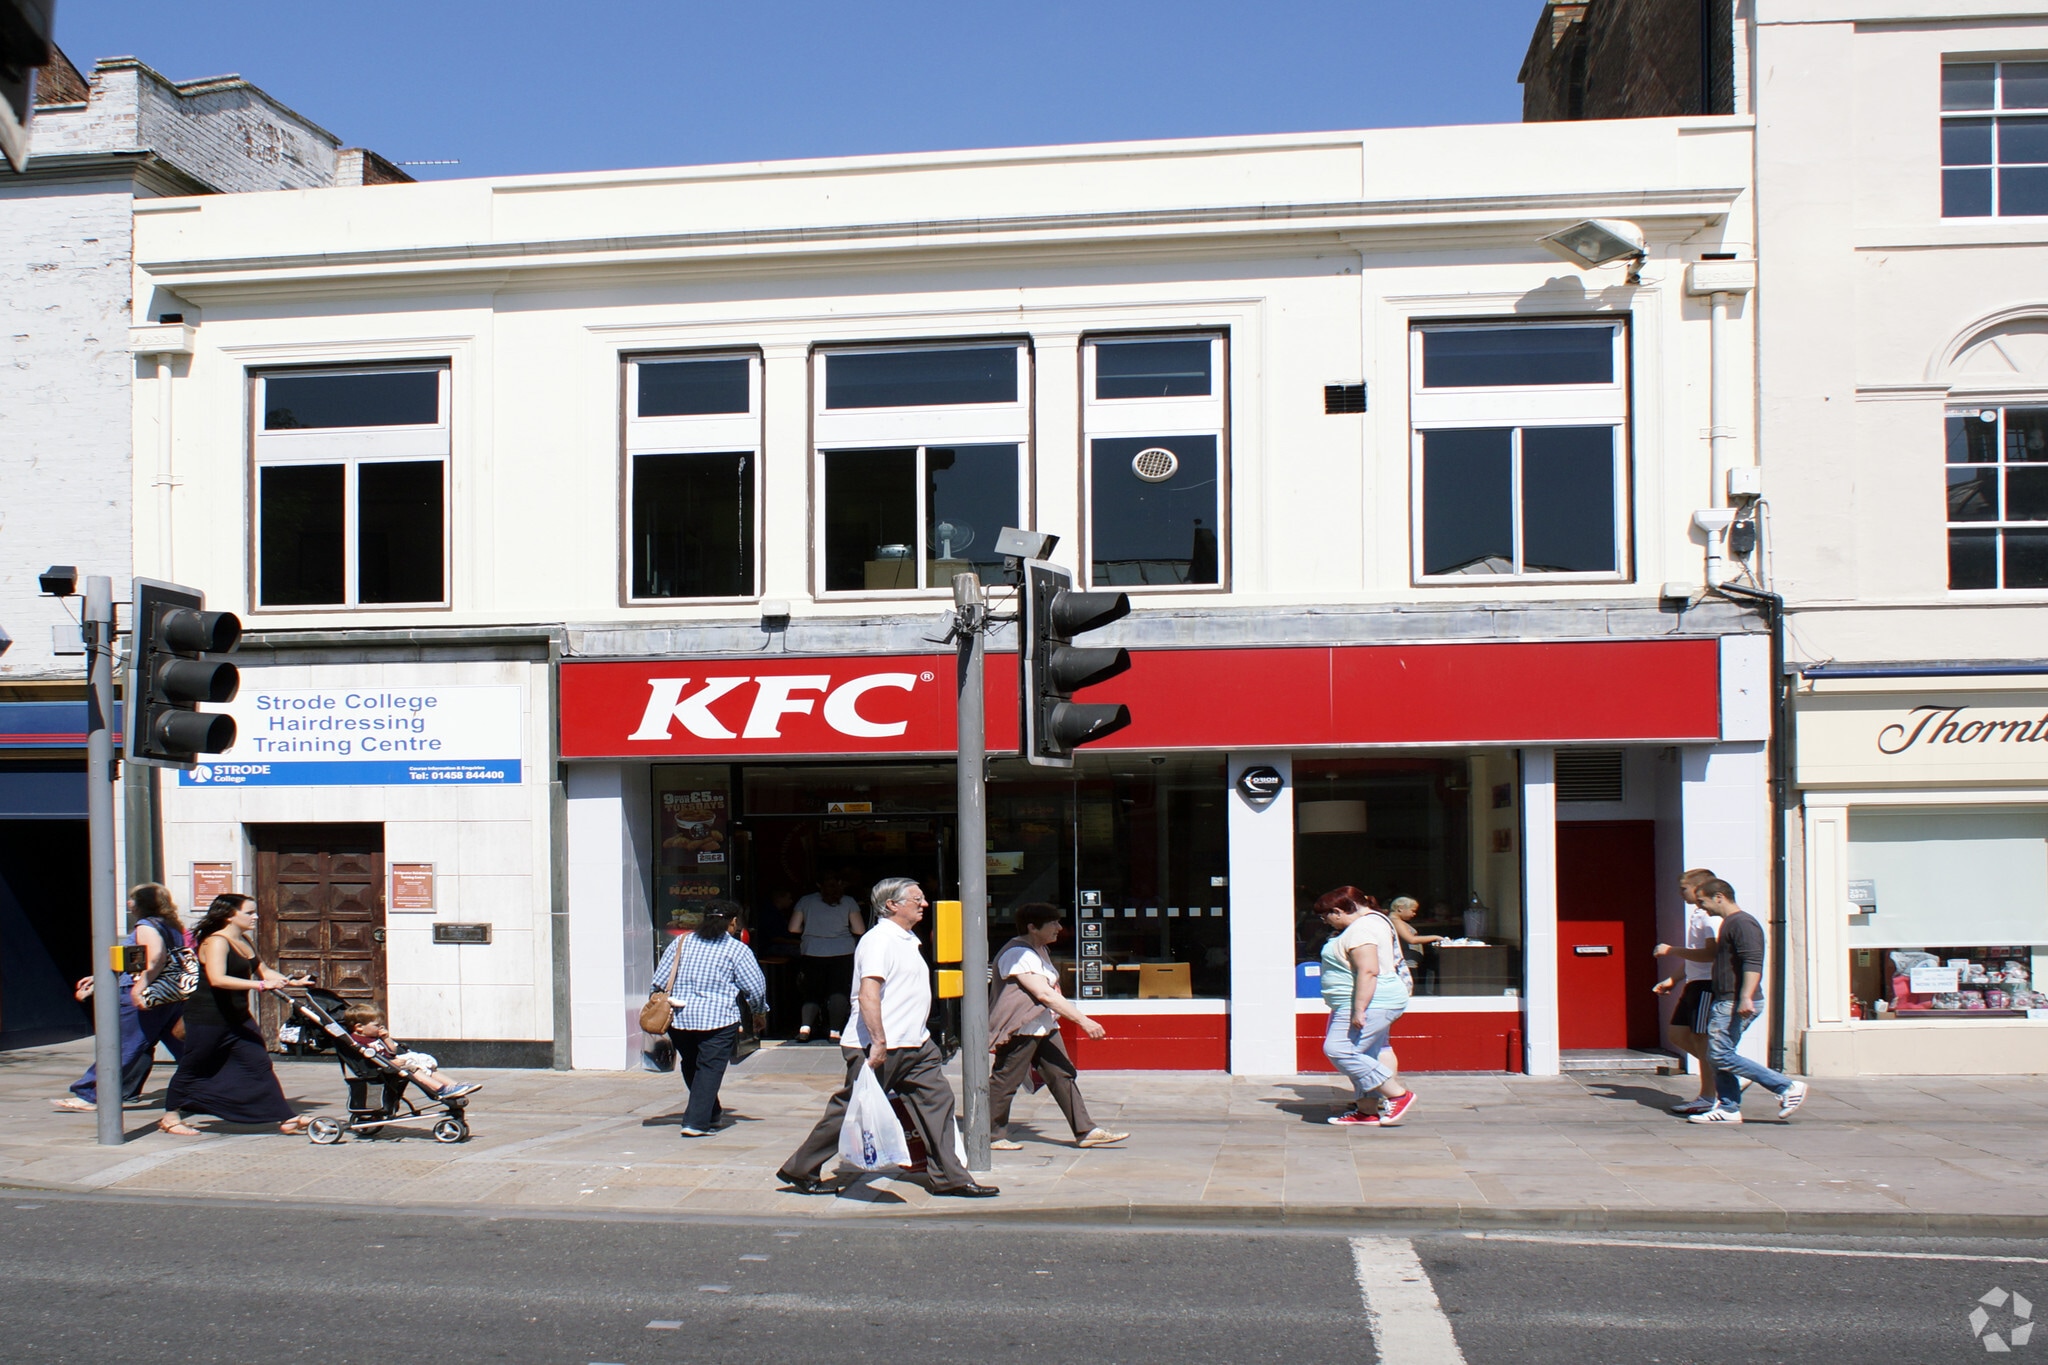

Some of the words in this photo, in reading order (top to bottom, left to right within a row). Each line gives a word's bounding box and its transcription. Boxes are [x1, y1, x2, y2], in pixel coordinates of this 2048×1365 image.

[256, 695, 336, 710] Strode
[345, 694, 438, 712] College
[627, 672, 917, 741] KFC
[269, 715, 426, 733] Hairdressing
[1877, 704, 2048, 755] Thornt
[253, 737, 352, 755] Training
[361, 736, 442, 751] Centre
[214, 765, 271, 775] STRODE
[409, 772, 429, 780] Tel:
[431, 771, 464, 779] 01458
[465, 771, 504, 779] 844400
[214, 775, 246, 783] College
[664, 801, 725, 812] TUESDAYS
[669, 886, 720, 896] NACHO
